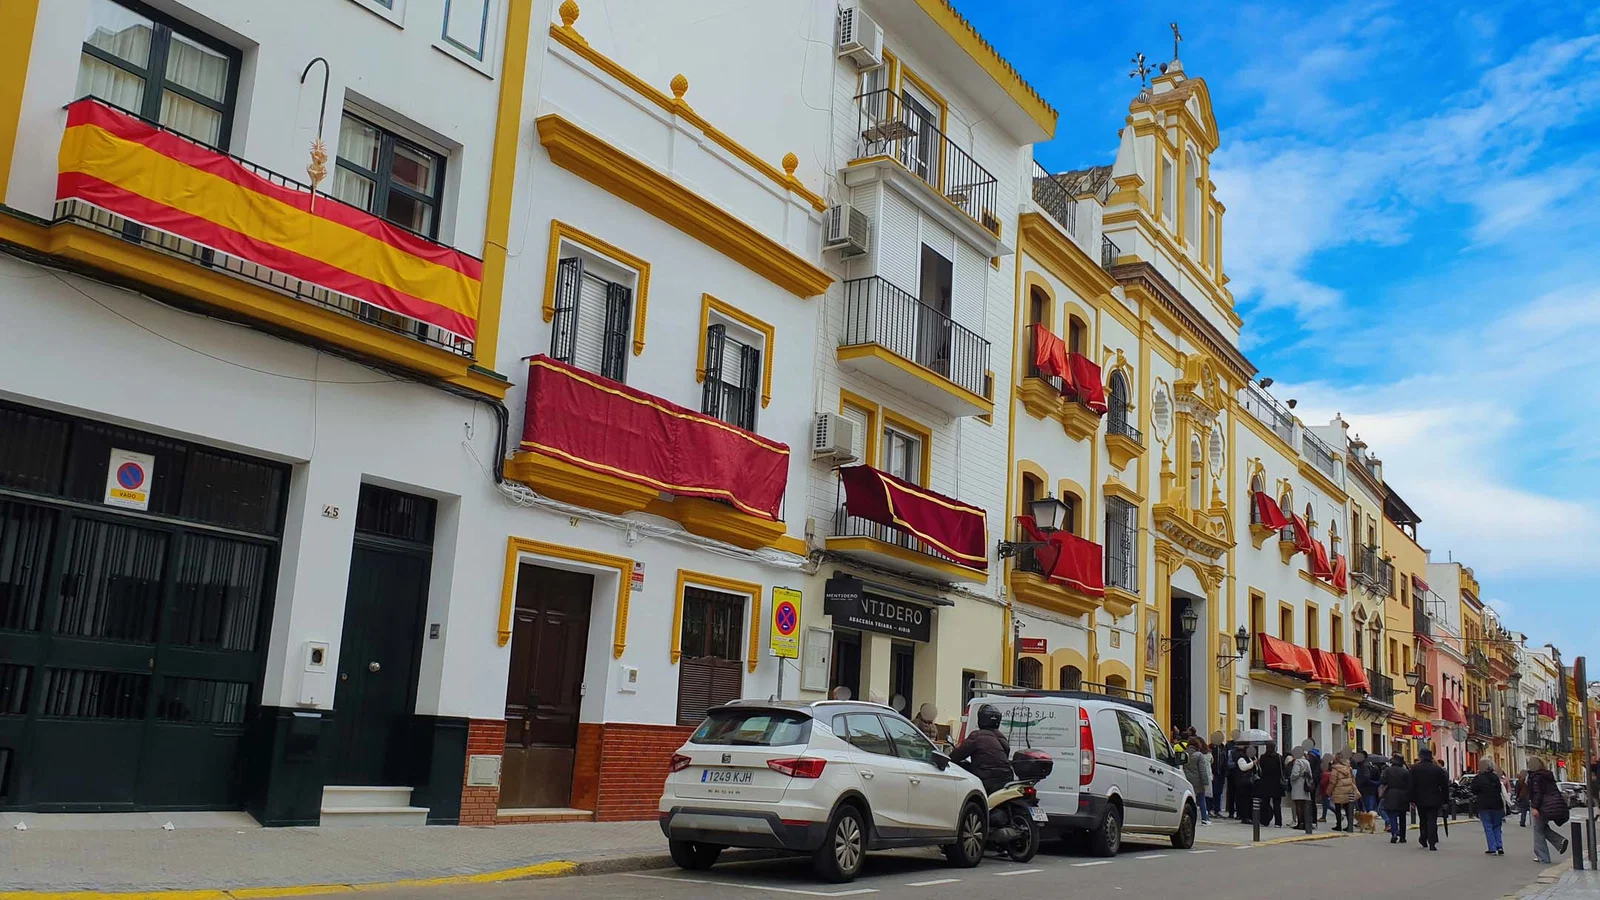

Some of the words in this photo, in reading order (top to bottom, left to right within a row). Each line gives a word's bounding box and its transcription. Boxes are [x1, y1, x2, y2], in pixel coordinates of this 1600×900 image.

[324, 505, 339, 517] 45
[861, 598, 923, 625] NTIDERO
[710, 771, 731, 782] 1249
[733, 772, 752, 783] KJH
